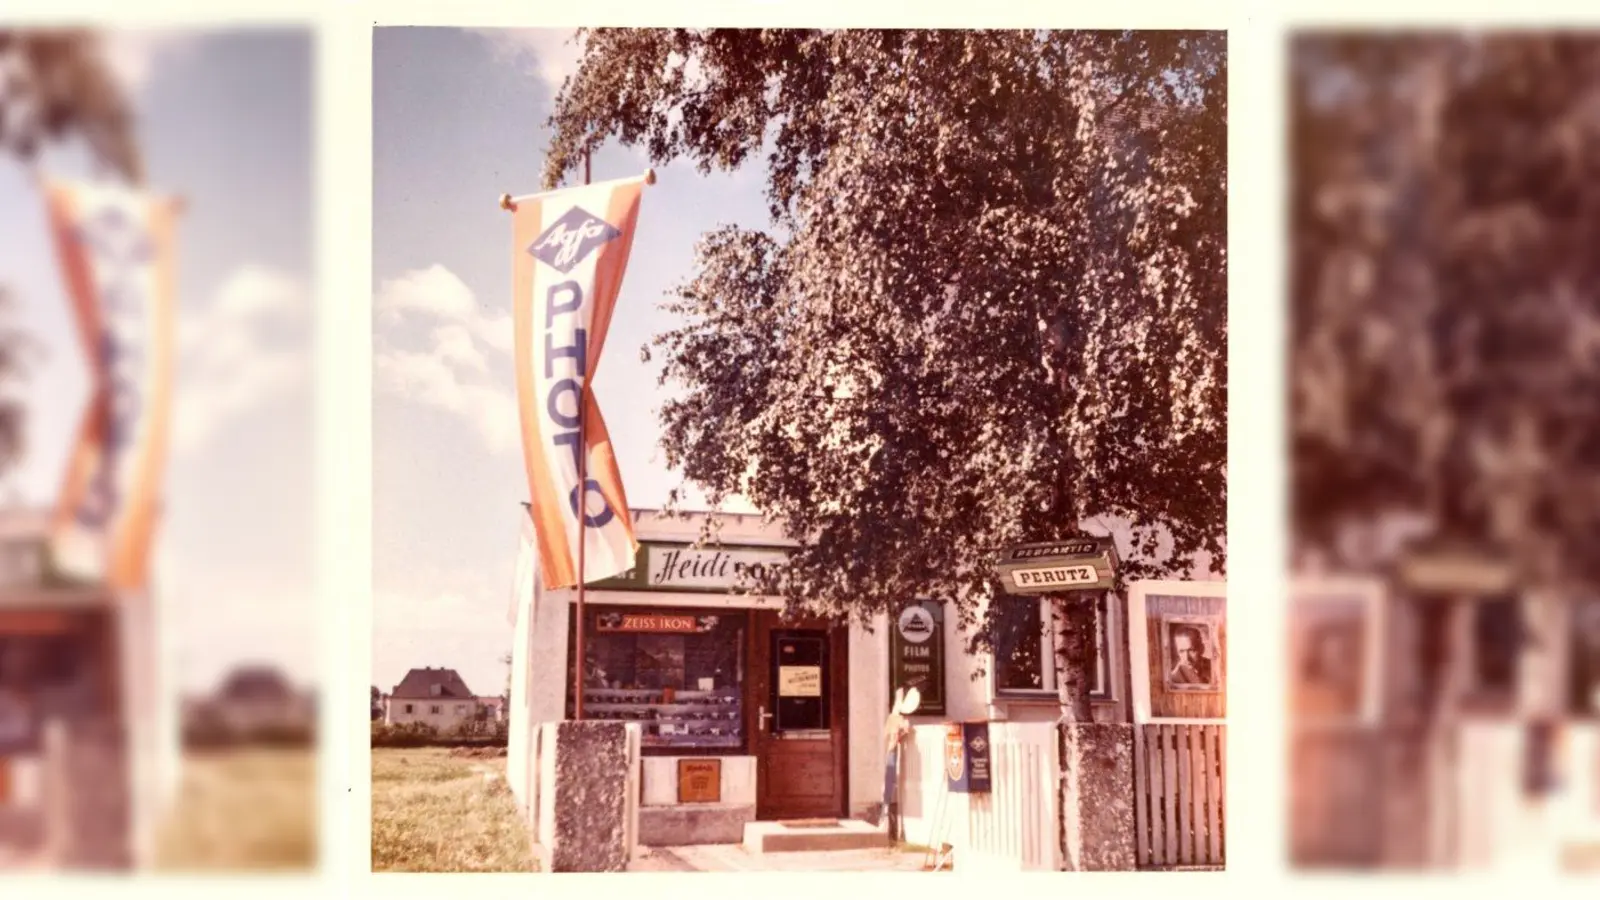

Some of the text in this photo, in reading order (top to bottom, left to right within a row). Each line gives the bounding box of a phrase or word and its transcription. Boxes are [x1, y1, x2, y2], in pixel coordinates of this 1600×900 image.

[533, 218, 605, 267] Agfa
[655, 549, 731, 585] Heidi
[1020, 568, 1090, 584] PERUTZ
[624, 617, 691, 629] ZEISS IKON
[904, 646, 930, 657] FILM
